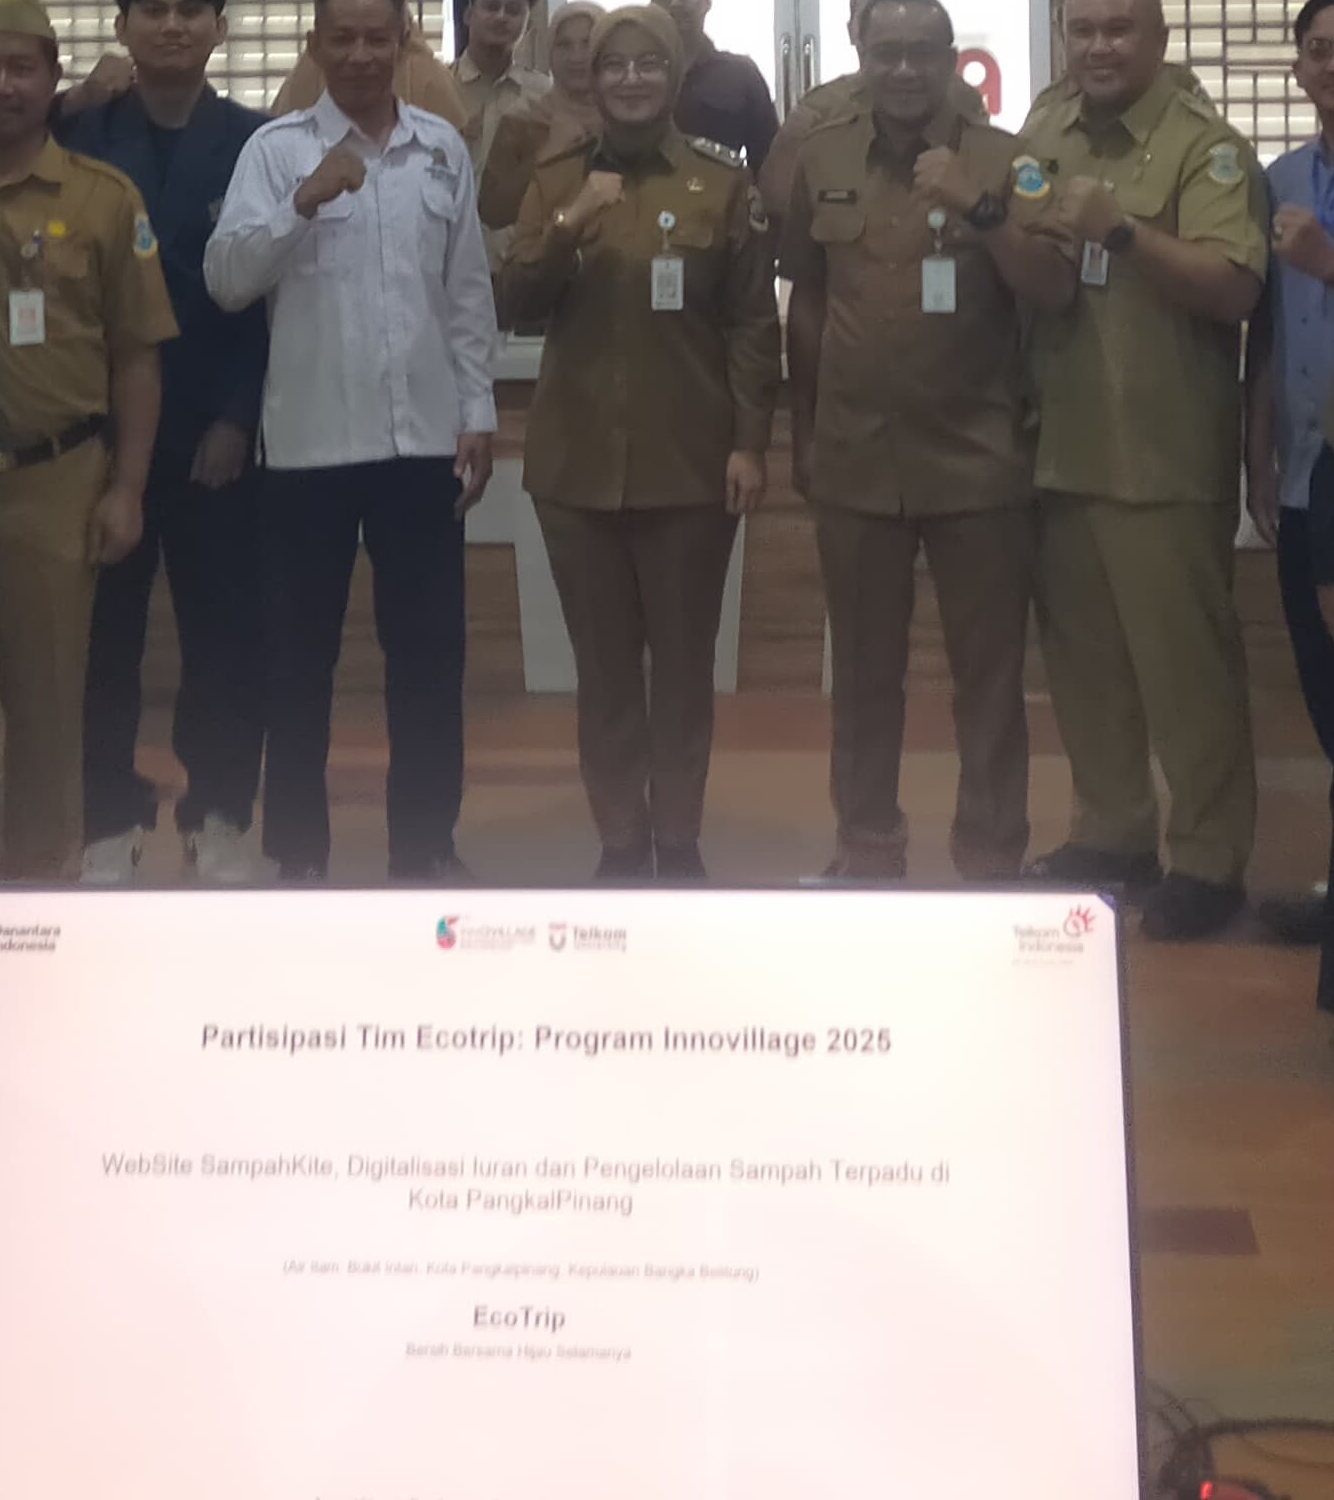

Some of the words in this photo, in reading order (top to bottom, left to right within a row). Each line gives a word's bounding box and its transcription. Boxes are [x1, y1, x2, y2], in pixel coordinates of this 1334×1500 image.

[573, 925, 627, 940] Telkom
[201, 1023, 346, 1056] Partisipasi
[357, 1024, 405, 1050] Tim
[416, 1023, 523, 1057] Ecotrip:
[535, 1025, 653, 1057] Program
[663, 1025, 816, 1058] Innovillage
[826, 1026, 891, 1052] 2025
[101, 1152, 192, 1176] WebSite
[200, 1152, 338, 1181] SampahKite,
[347, 1154, 464, 1182] Digitalisasi
[472, 1155, 527, 1178] Iuran
[535, 1157, 575, 1179] dan
[584, 1156, 721, 1183] Pengelolaan
[730, 1158, 822, 1185] Sampah
[830, 1159, 923, 1187] Terpadu
[931, 1159, 950, 1183] di
[408, 1187, 458, 1211] Kota
[466, 1187, 633, 1216] PangkalPinang
[472, 1304, 566, 1333] EcoTrip
[404, 1342, 448, 1358] Bersih
[452, 1343, 513, 1359] Bersama
